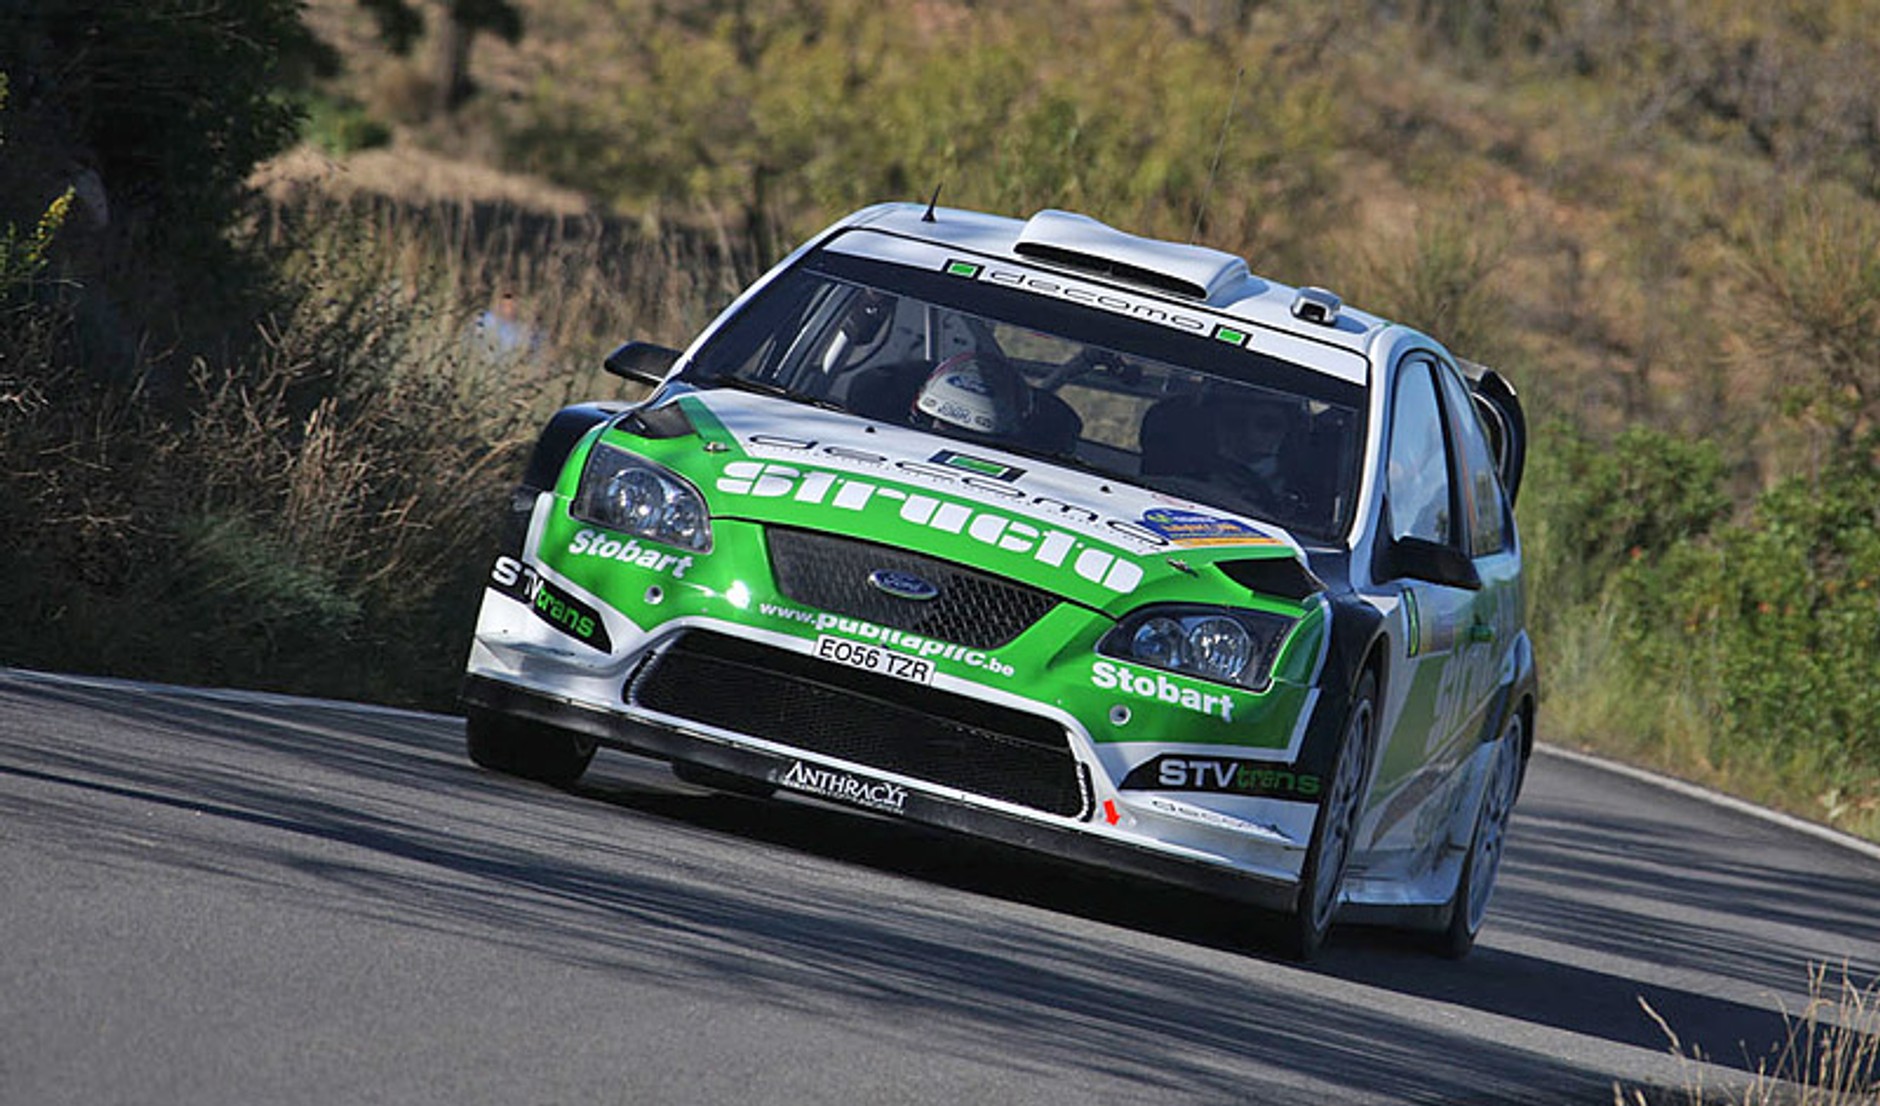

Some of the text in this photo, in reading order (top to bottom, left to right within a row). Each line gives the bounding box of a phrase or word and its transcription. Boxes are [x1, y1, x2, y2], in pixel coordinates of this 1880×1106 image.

[990, 270, 1205, 332] decomo
[748, 434, 1170, 547] decomo
[568, 528, 694, 578] Stobart
[819, 637, 929, 683] EO56 TZR
[1090, 661, 1235, 723] Stobart
[1158, 757, 1322, 794] STVtrans
